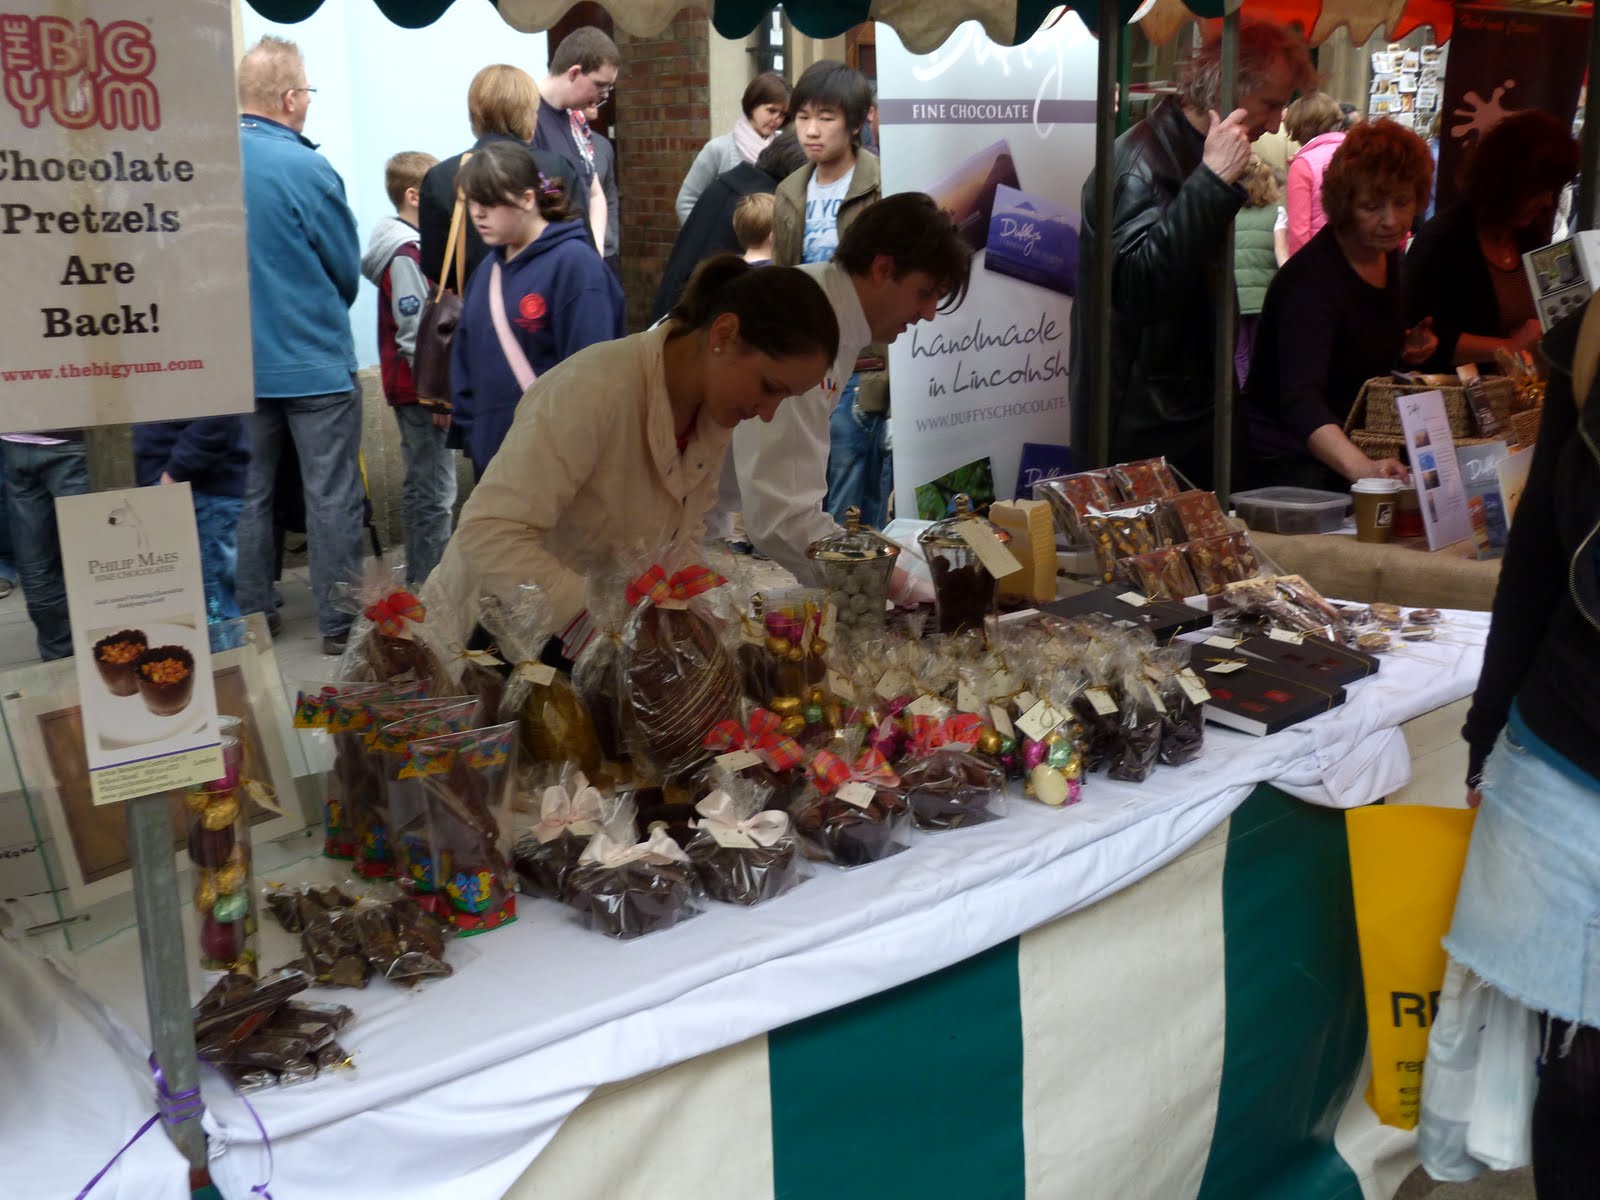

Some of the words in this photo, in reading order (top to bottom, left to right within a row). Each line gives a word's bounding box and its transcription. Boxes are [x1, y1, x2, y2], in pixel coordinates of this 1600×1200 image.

[1, 14, 34, 72] THE
[35, 16, 156, 78] BIG
[912, 104, 947, 119] FINE
[949, 104, 1029, 119] CHOCOLATE
[1, 203, 181, 235] Pretzels
[60, 255, 136, 286] Are
[41, 302, 160, 339] Back!
[911, 311, 1063, 359] handmade
[1, 359, 205, 382] www.thebigyum.com
[928, 377, 947, 397] in
[953, 350, 1070, 394] Lincolnsh
